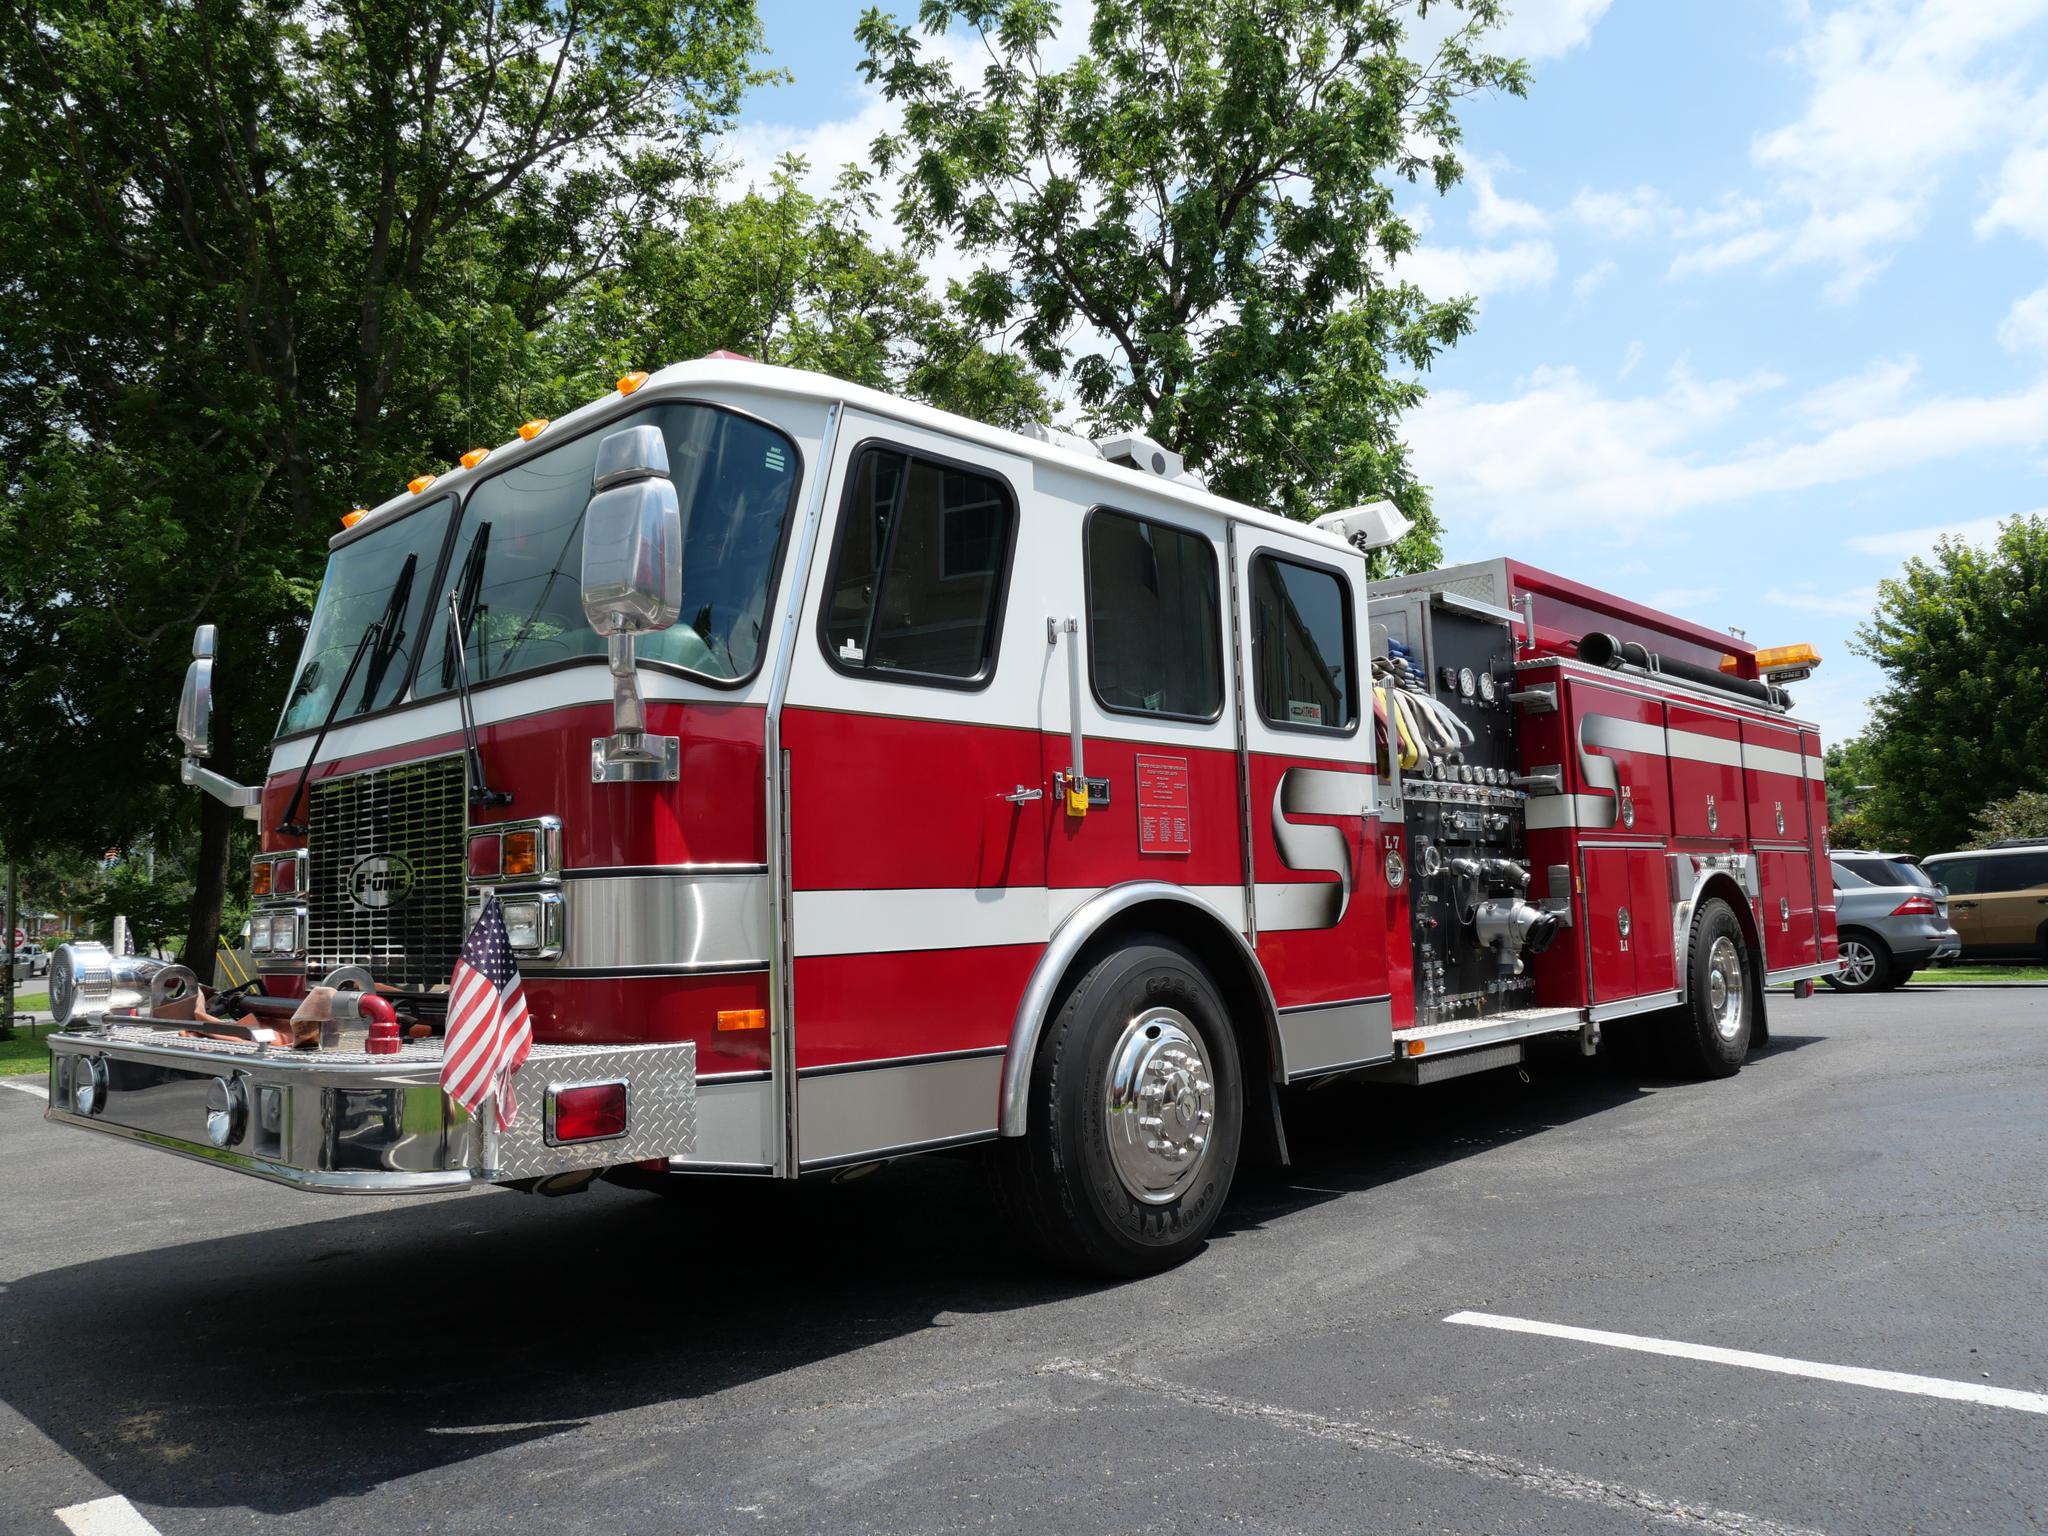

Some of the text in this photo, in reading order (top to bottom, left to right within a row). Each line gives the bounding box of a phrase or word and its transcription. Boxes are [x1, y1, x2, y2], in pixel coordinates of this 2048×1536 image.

[1621, 786, 1631, 798] L3
[1706, 794, 1715, 805] L4
[1384, 835, 1400, 849] L7
[355, 869, 407, 893] E-ONE
[1620, 940, 1628, 951] L1
